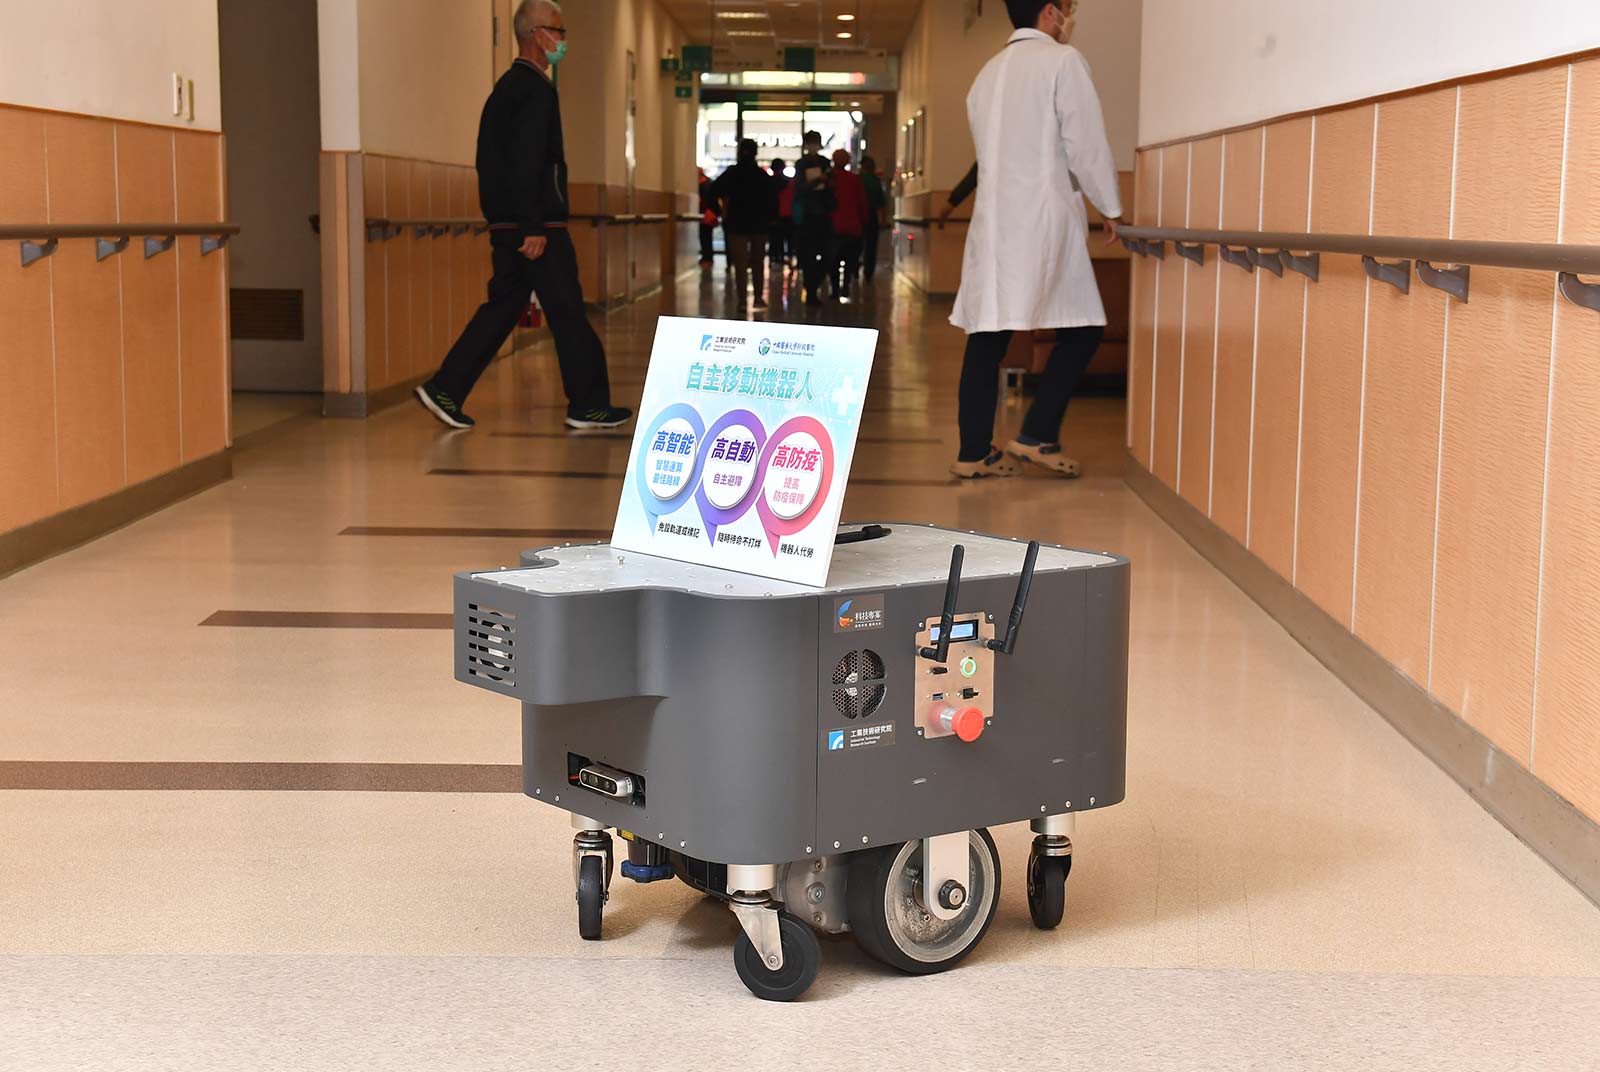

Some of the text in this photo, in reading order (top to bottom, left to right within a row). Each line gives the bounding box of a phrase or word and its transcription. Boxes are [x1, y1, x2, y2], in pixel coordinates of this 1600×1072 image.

[686, 362, 815, 401] 自主移動機器人
[652, 430, 695, 455] 高智能
[711, 437, 756, 463] 高自動
[655, 459, 684, 473] 智慧運算
[771, 444, 820, 472] 高防疫
[653, 472, 681, 486] 最佳路線
[713, 473, 743, 487] 自主避障
[783, 476, 801, 490] 提高
[773, 490, 806, 506] 防疫保障
[657, 521, 701, 539] 免設軌道或標記
[717, 531, 762, 549] 隨時待命不打烊
[780, 543, 814, 558] 機器人代勞
[850, 724, 893, 738] 工業技術研究院
